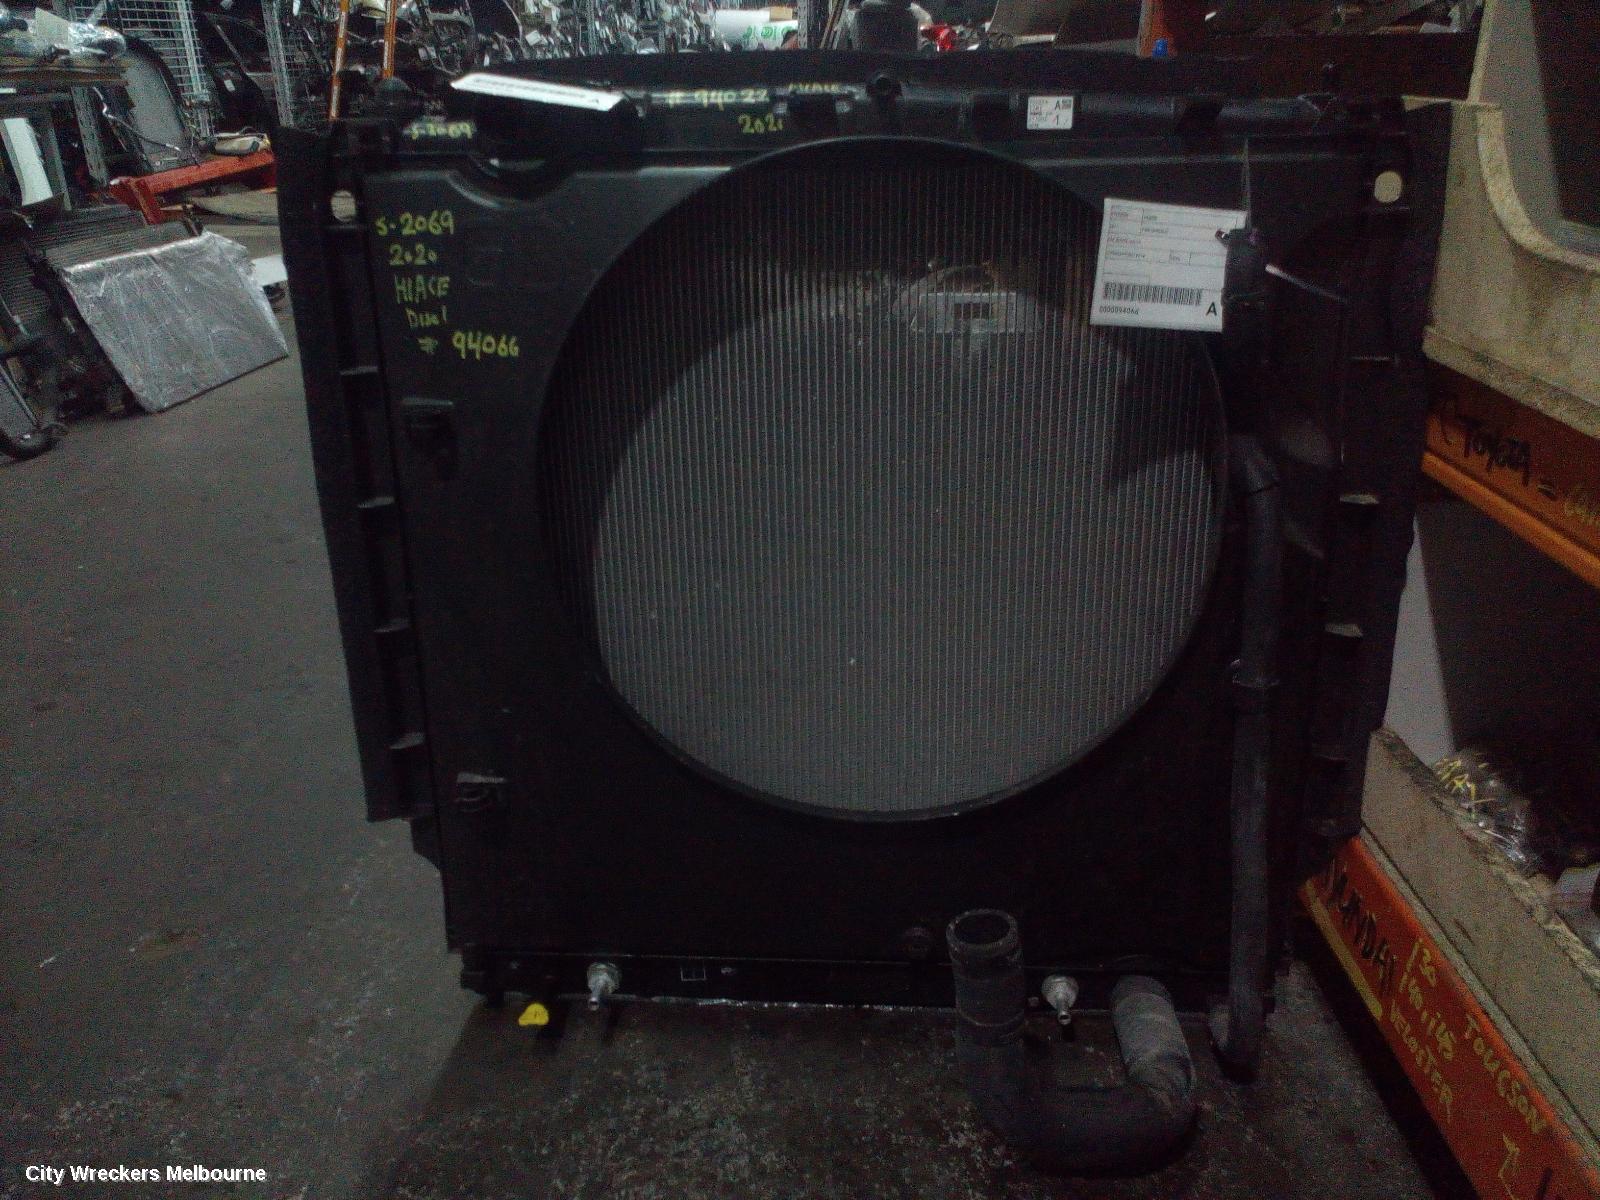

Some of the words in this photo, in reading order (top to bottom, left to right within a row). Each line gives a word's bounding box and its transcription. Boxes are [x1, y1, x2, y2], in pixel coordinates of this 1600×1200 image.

[388, 243, 438, 266] 2020
[394, 274, 451, 304] HIACE
[1205, 301, 1218, 317] A
[452, 330, 520, 361] 94066
